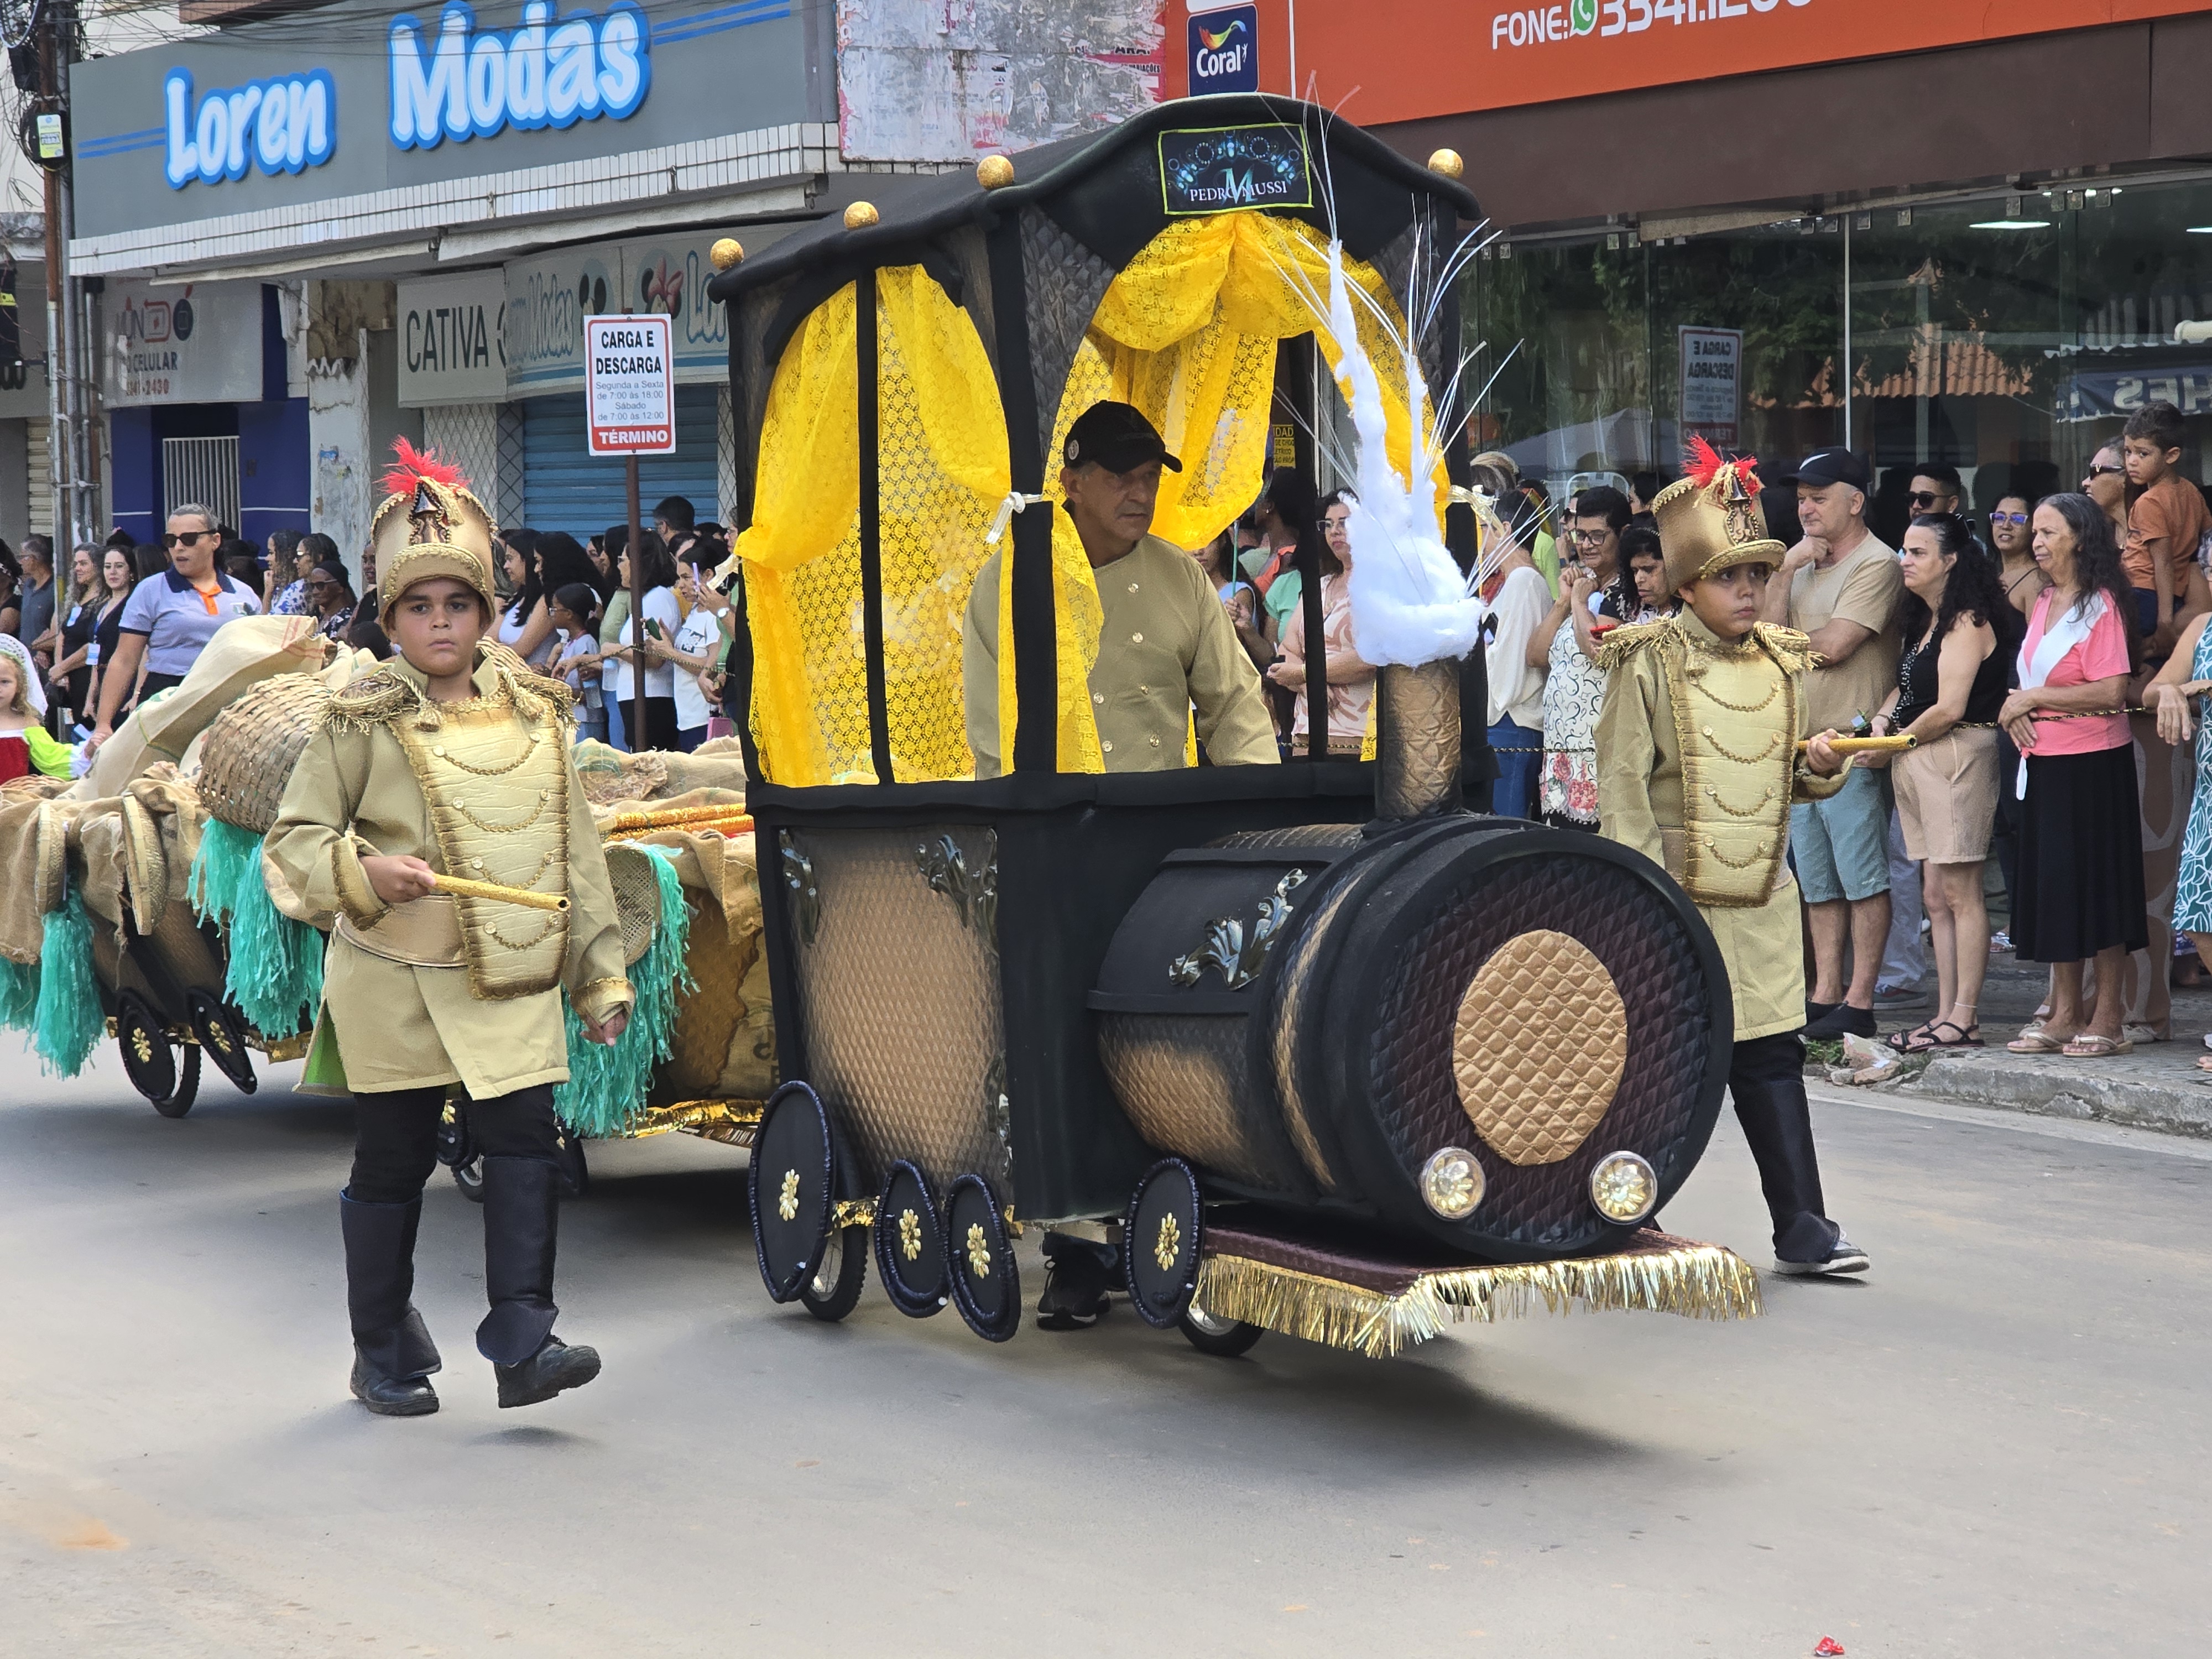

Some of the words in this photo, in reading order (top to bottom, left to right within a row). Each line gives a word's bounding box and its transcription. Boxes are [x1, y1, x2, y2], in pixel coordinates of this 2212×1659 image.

[1493, 7, 1568, 49] FONE:
[1197, 44, 1241, 77] Coral
[389, 1, 647, 147] Modas
[166, 70, 333, 187] Loren
[1190, 186, 1235, 202] PEDRO
[1242, 181, 1288, 197] MUSSI
[406, 305, 489, 373] CATIVA
[601, 331, 643, 349] CARGA
[646, 331, 654, 347] E
[133, 351, 178, 372] CELULAR
[596, 357, 662, 375] DESCARGA
[596, 381, 632, 390] Segunda
[641, 380, 664, 388] Sexta
[629, 390, 639, 399] às
[642, 390, 664, 398] 18:00
[598, 413, 608, 421] de
[630, 411, 640, 420] às
[643, 411, 664, 420] 12:00
[598, 429, 668, 445] TÉRMINO
